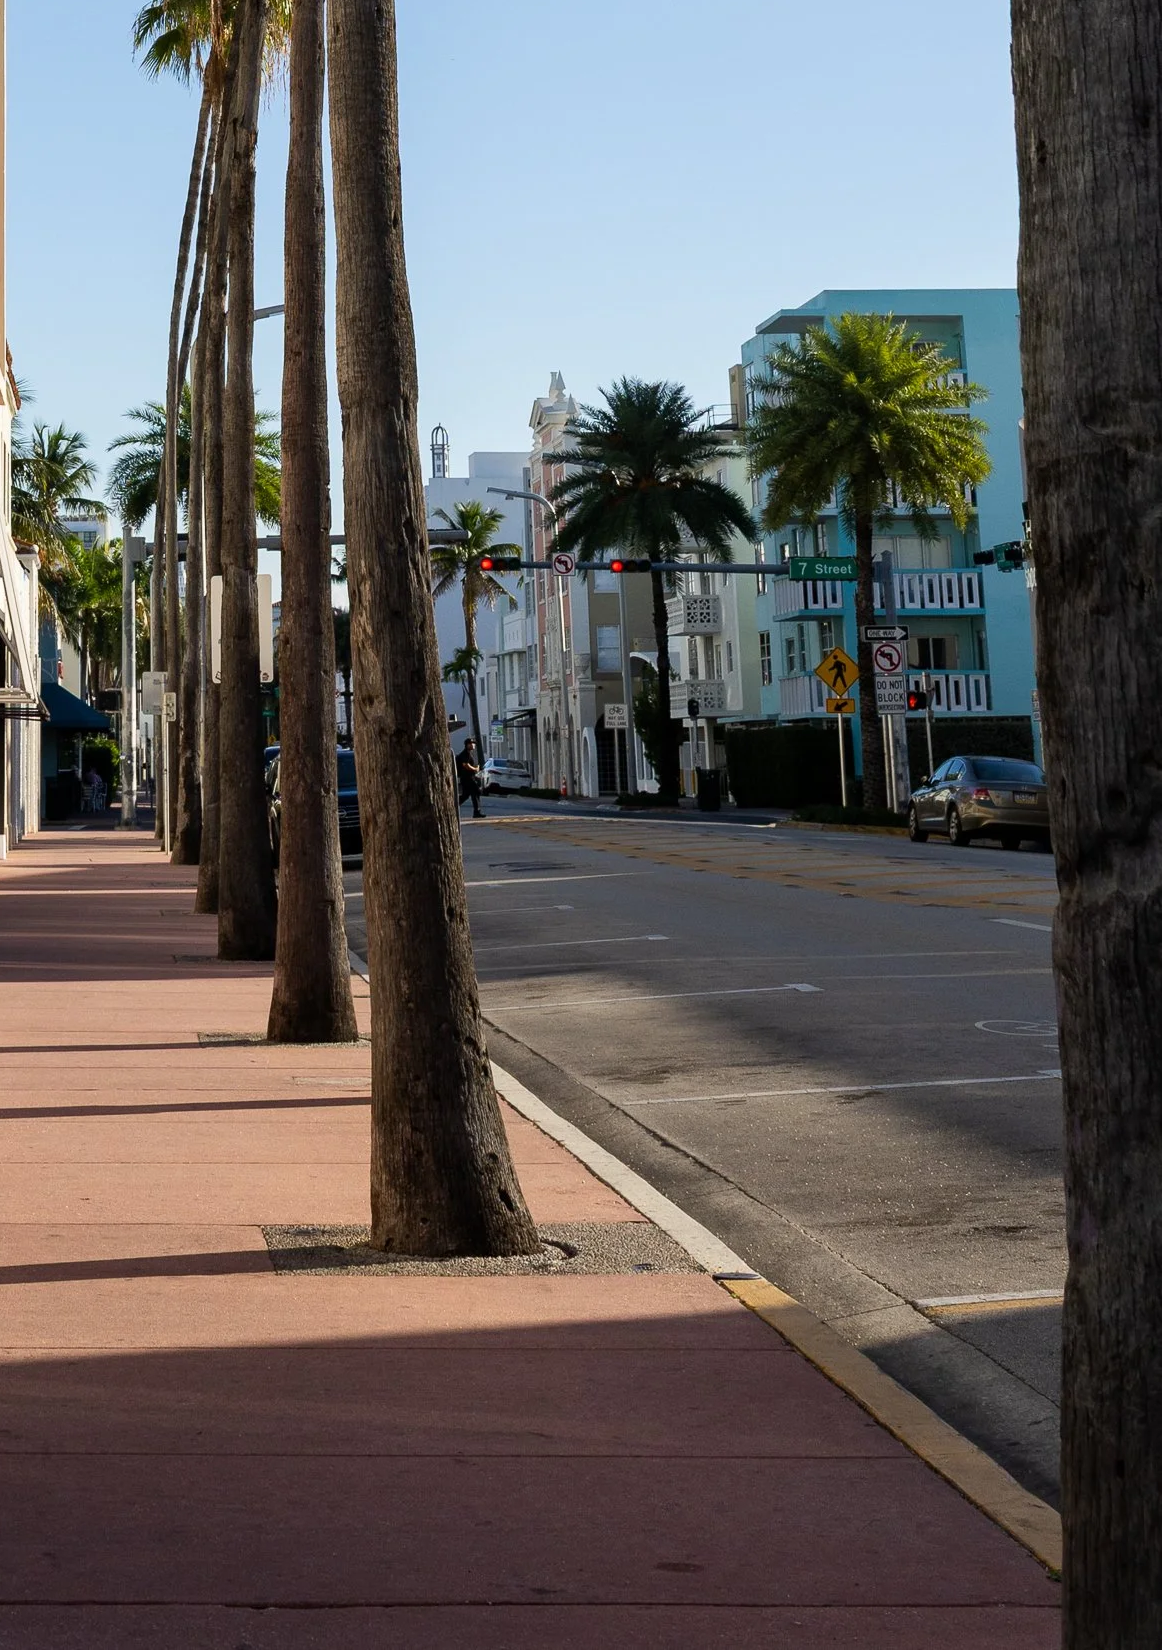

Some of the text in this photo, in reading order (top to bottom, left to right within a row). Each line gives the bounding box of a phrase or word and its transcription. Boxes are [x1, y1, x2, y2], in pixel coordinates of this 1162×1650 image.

[798, 562, 852, 575] 7 Street
[877, 680, 903, 690] DO NOT
[878, 692, 905, 703] BLOCK
